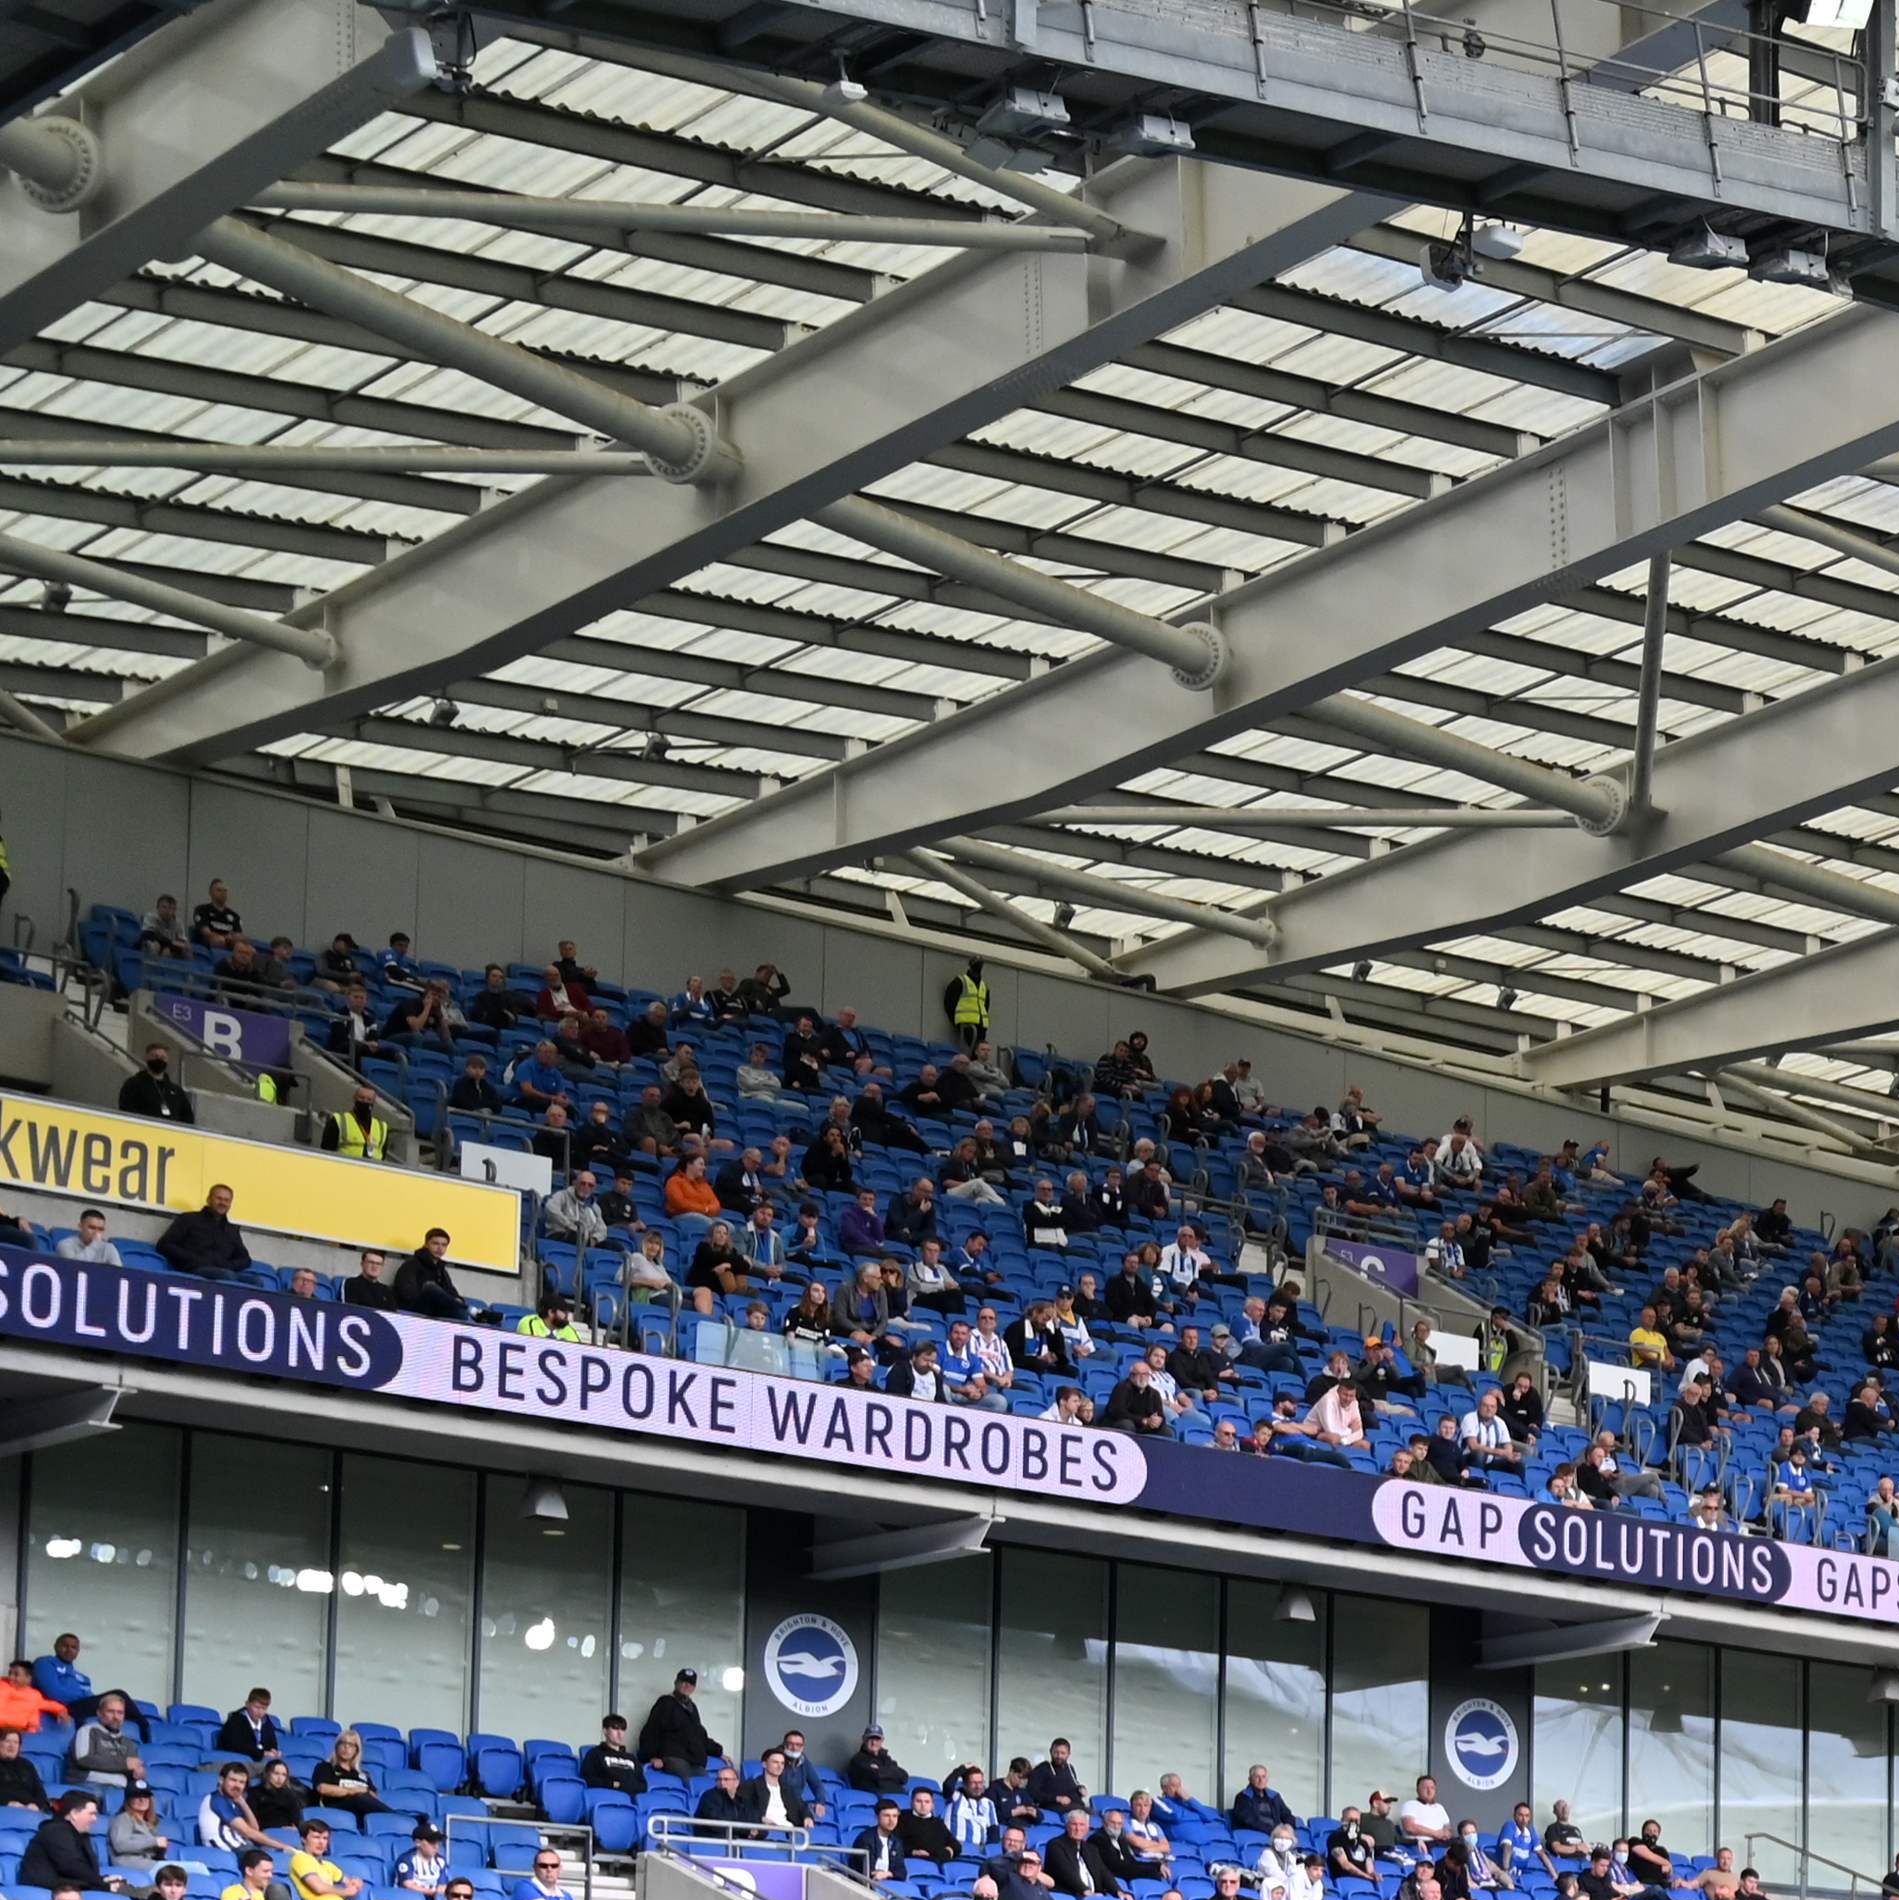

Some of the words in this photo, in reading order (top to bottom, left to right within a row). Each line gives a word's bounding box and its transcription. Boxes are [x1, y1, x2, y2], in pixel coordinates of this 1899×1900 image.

[172, 1003, 192, 1022] E3
[203, 1010, 242, 1061] B
[0, 1259, 372, 1378] OLUTIONS
[452, 1334, 737, 1434] BESPOKE
[767, 1385, 1118, 1492] WARDROBES
[1402, 1490, 1503, 1550] GAP
[1533, 1510, 1774, 1595] SOLUTIONS
[792, 1702, 829, 1714] ALBION
